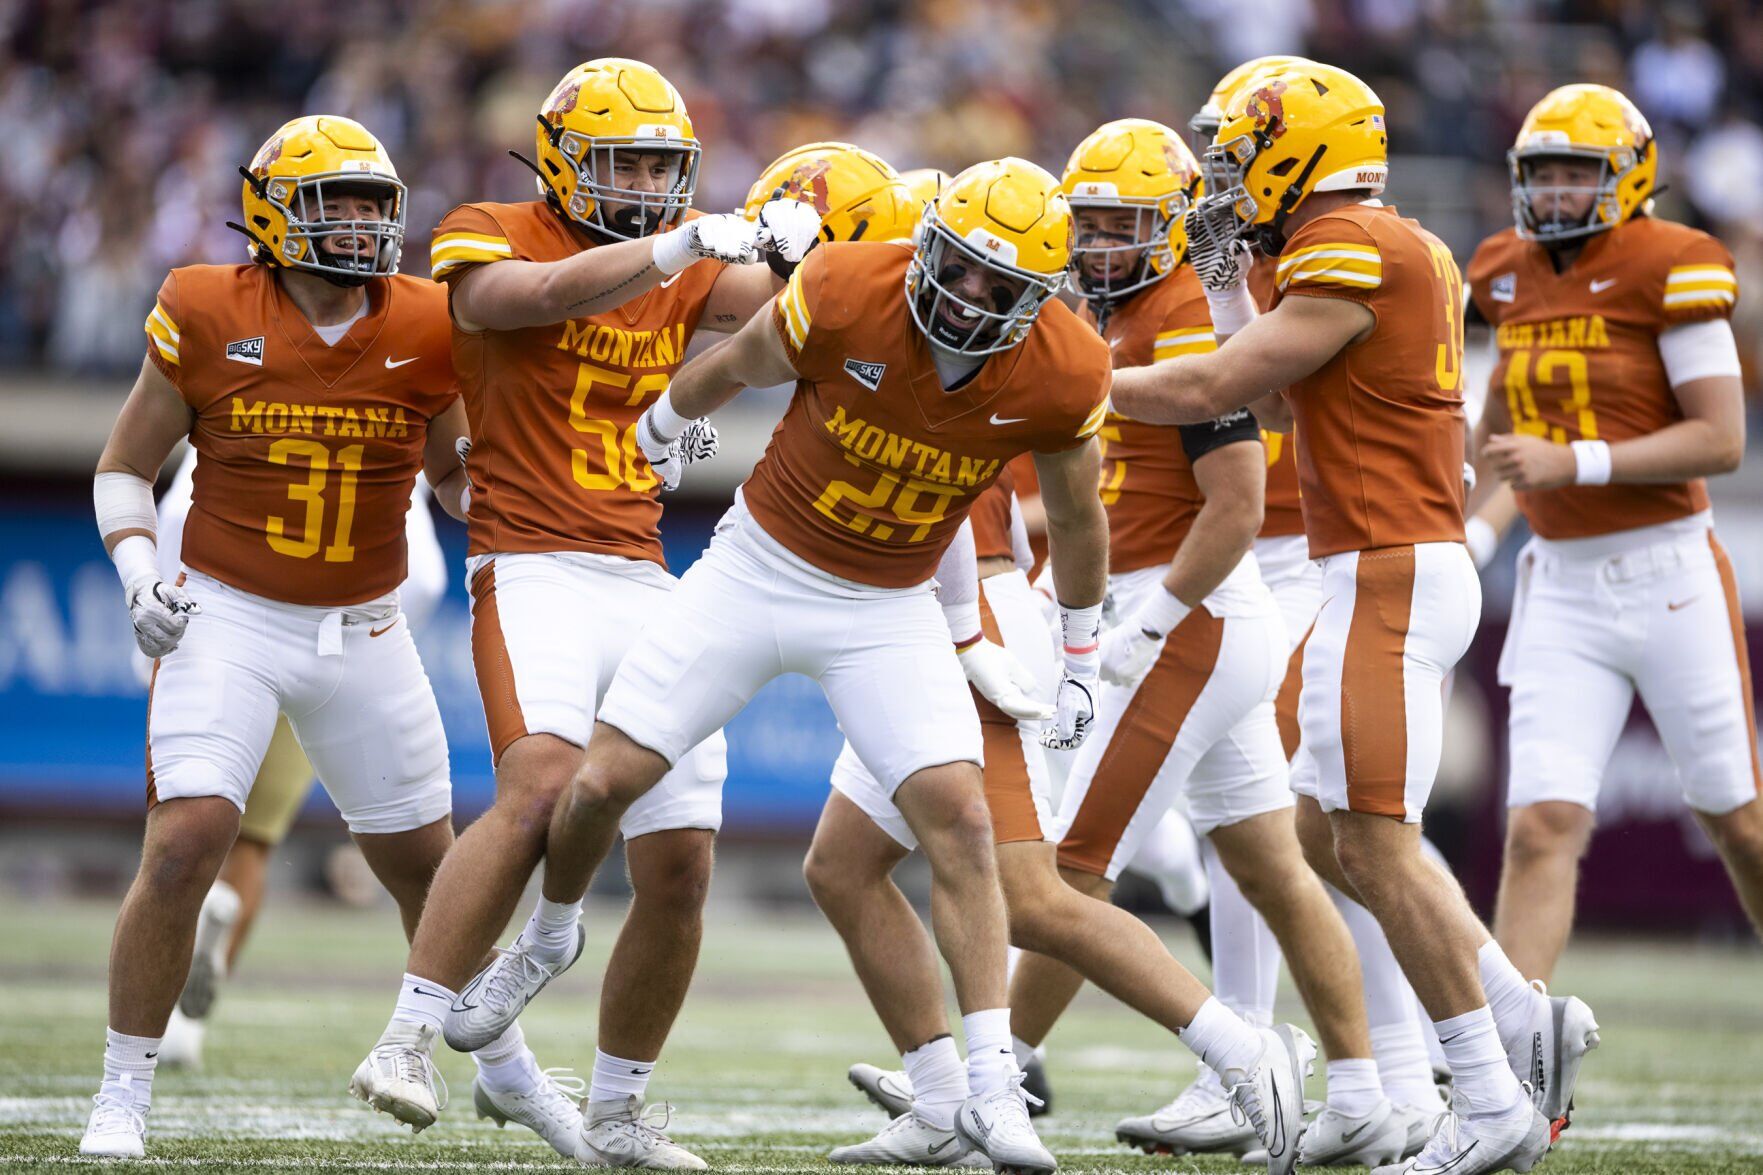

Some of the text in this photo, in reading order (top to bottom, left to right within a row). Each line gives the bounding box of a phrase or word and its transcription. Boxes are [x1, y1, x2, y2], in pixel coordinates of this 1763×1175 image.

[229, 397, 408, 438] MONTANA
[824, 405, 999, 487] MONTANA
[266, 438, 364, 562] 31
[812, 451, 966, 543] 29
